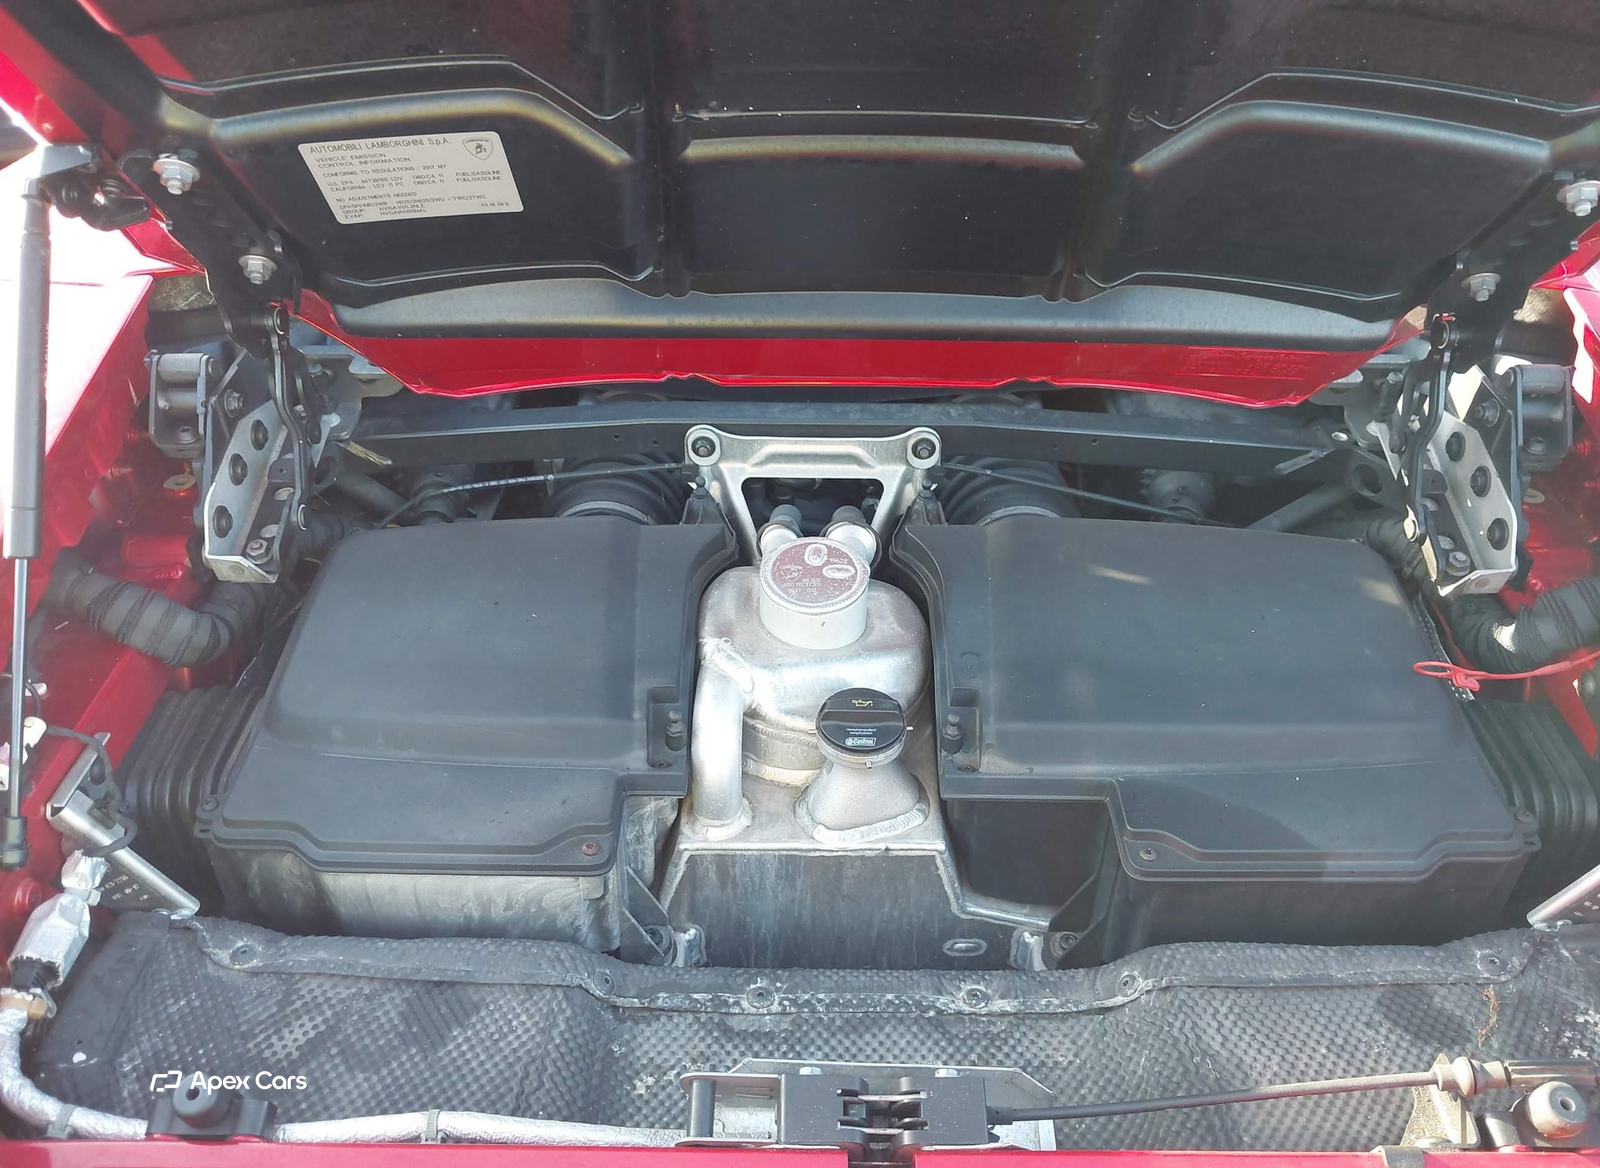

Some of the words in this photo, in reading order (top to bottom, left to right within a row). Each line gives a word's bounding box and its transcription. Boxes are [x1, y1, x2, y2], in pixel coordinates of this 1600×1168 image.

[310, 143, 362, 154] AUTOMOBILI
[364, 139, 424, 150] LAMBORGHINI
[318, 161, 355, 169] CONTROL
[359, 157, 411, 166] INFORMATION
[350, 153, 386, 161] EMISSION
[323, 170, 358, 178] CONFORMS
[372, 166, 415, 174] REGULATIONS
[348, 194, 391, 202] ADJUSTMENTS
